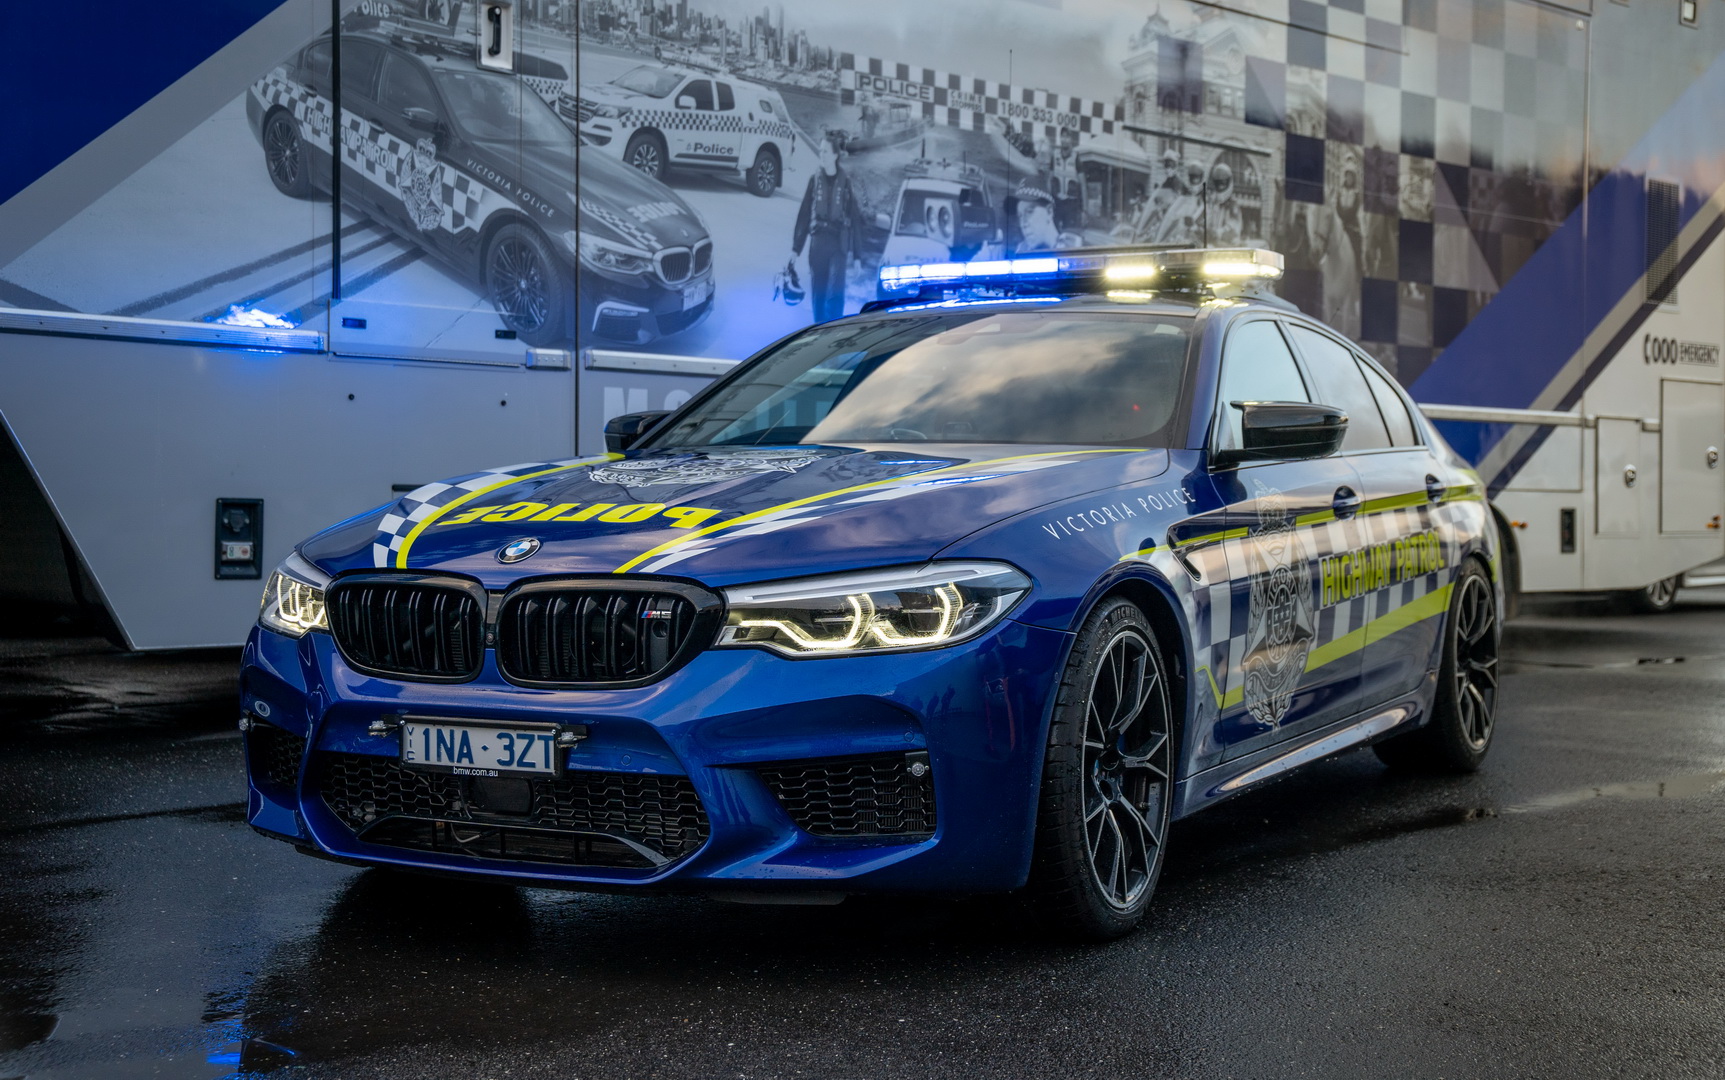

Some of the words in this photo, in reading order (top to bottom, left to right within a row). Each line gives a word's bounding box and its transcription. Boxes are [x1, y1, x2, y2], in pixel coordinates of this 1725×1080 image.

[354, 0, 390, 18] olice
[858, 74, 931, 100] POLICE
[307, 107, 352, 148] HIGHAY
[1001, 101, 1029, 119] 1800
[1032, 106, 1053, 123] 333
[1056, 110, 1077, 128] 000
[693, 142, 734, 155] Police
[467, 158, 511, 190] VICTORIA
[516, 188, 555, 218] POLICE
[1680, 343, 1720, 365] EMERGENCY
[1042, 502, 1137, 540] VICTORIA
[1137, 487, 1196, 513] POLICE
[1321, 543, 1391, 607] HIGHWAY
[1395, 530, 1445, 581] PATROL
[650, 610, 672, 619] M5
[453, 766, 499, 777] bmw.com.au
